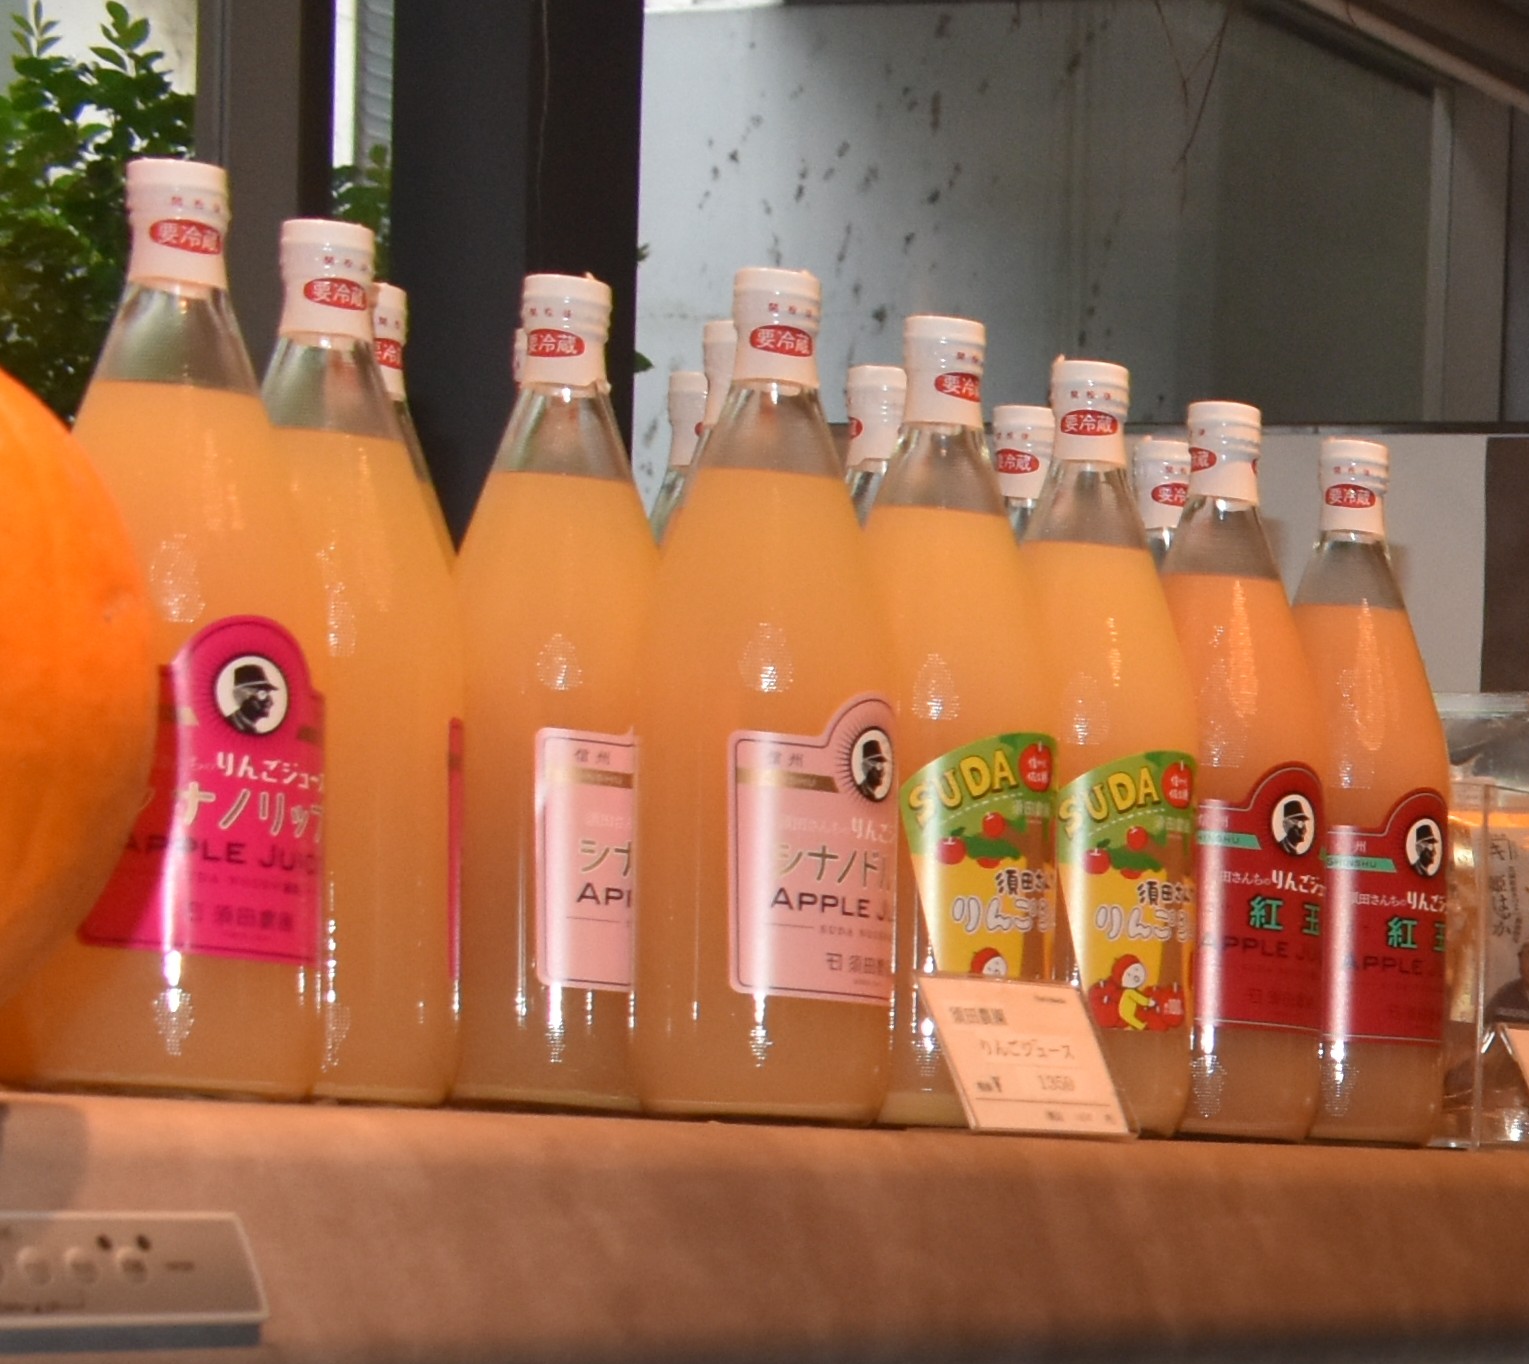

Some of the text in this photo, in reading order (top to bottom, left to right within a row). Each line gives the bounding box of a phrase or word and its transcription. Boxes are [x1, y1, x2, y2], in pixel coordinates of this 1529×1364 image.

[527, 330, 577, 355] 要冷蔵
[756, 328, 812, 355] 要冷蔵
[943, 374, 981, 400] 要冷
[1064, 413, 1119, 434] 要冷蔵
[1157, 486, 1188, 503] 要冷
[1328, 486, 1375, 506] 要冷蔵
[907, 748, 1020, 831] SUDA
[1058, 765, 1161, 839] SUDA
[769, 886, 872, 919] APPLE
[979, 1039, 1077, 1060] りんごジュース
